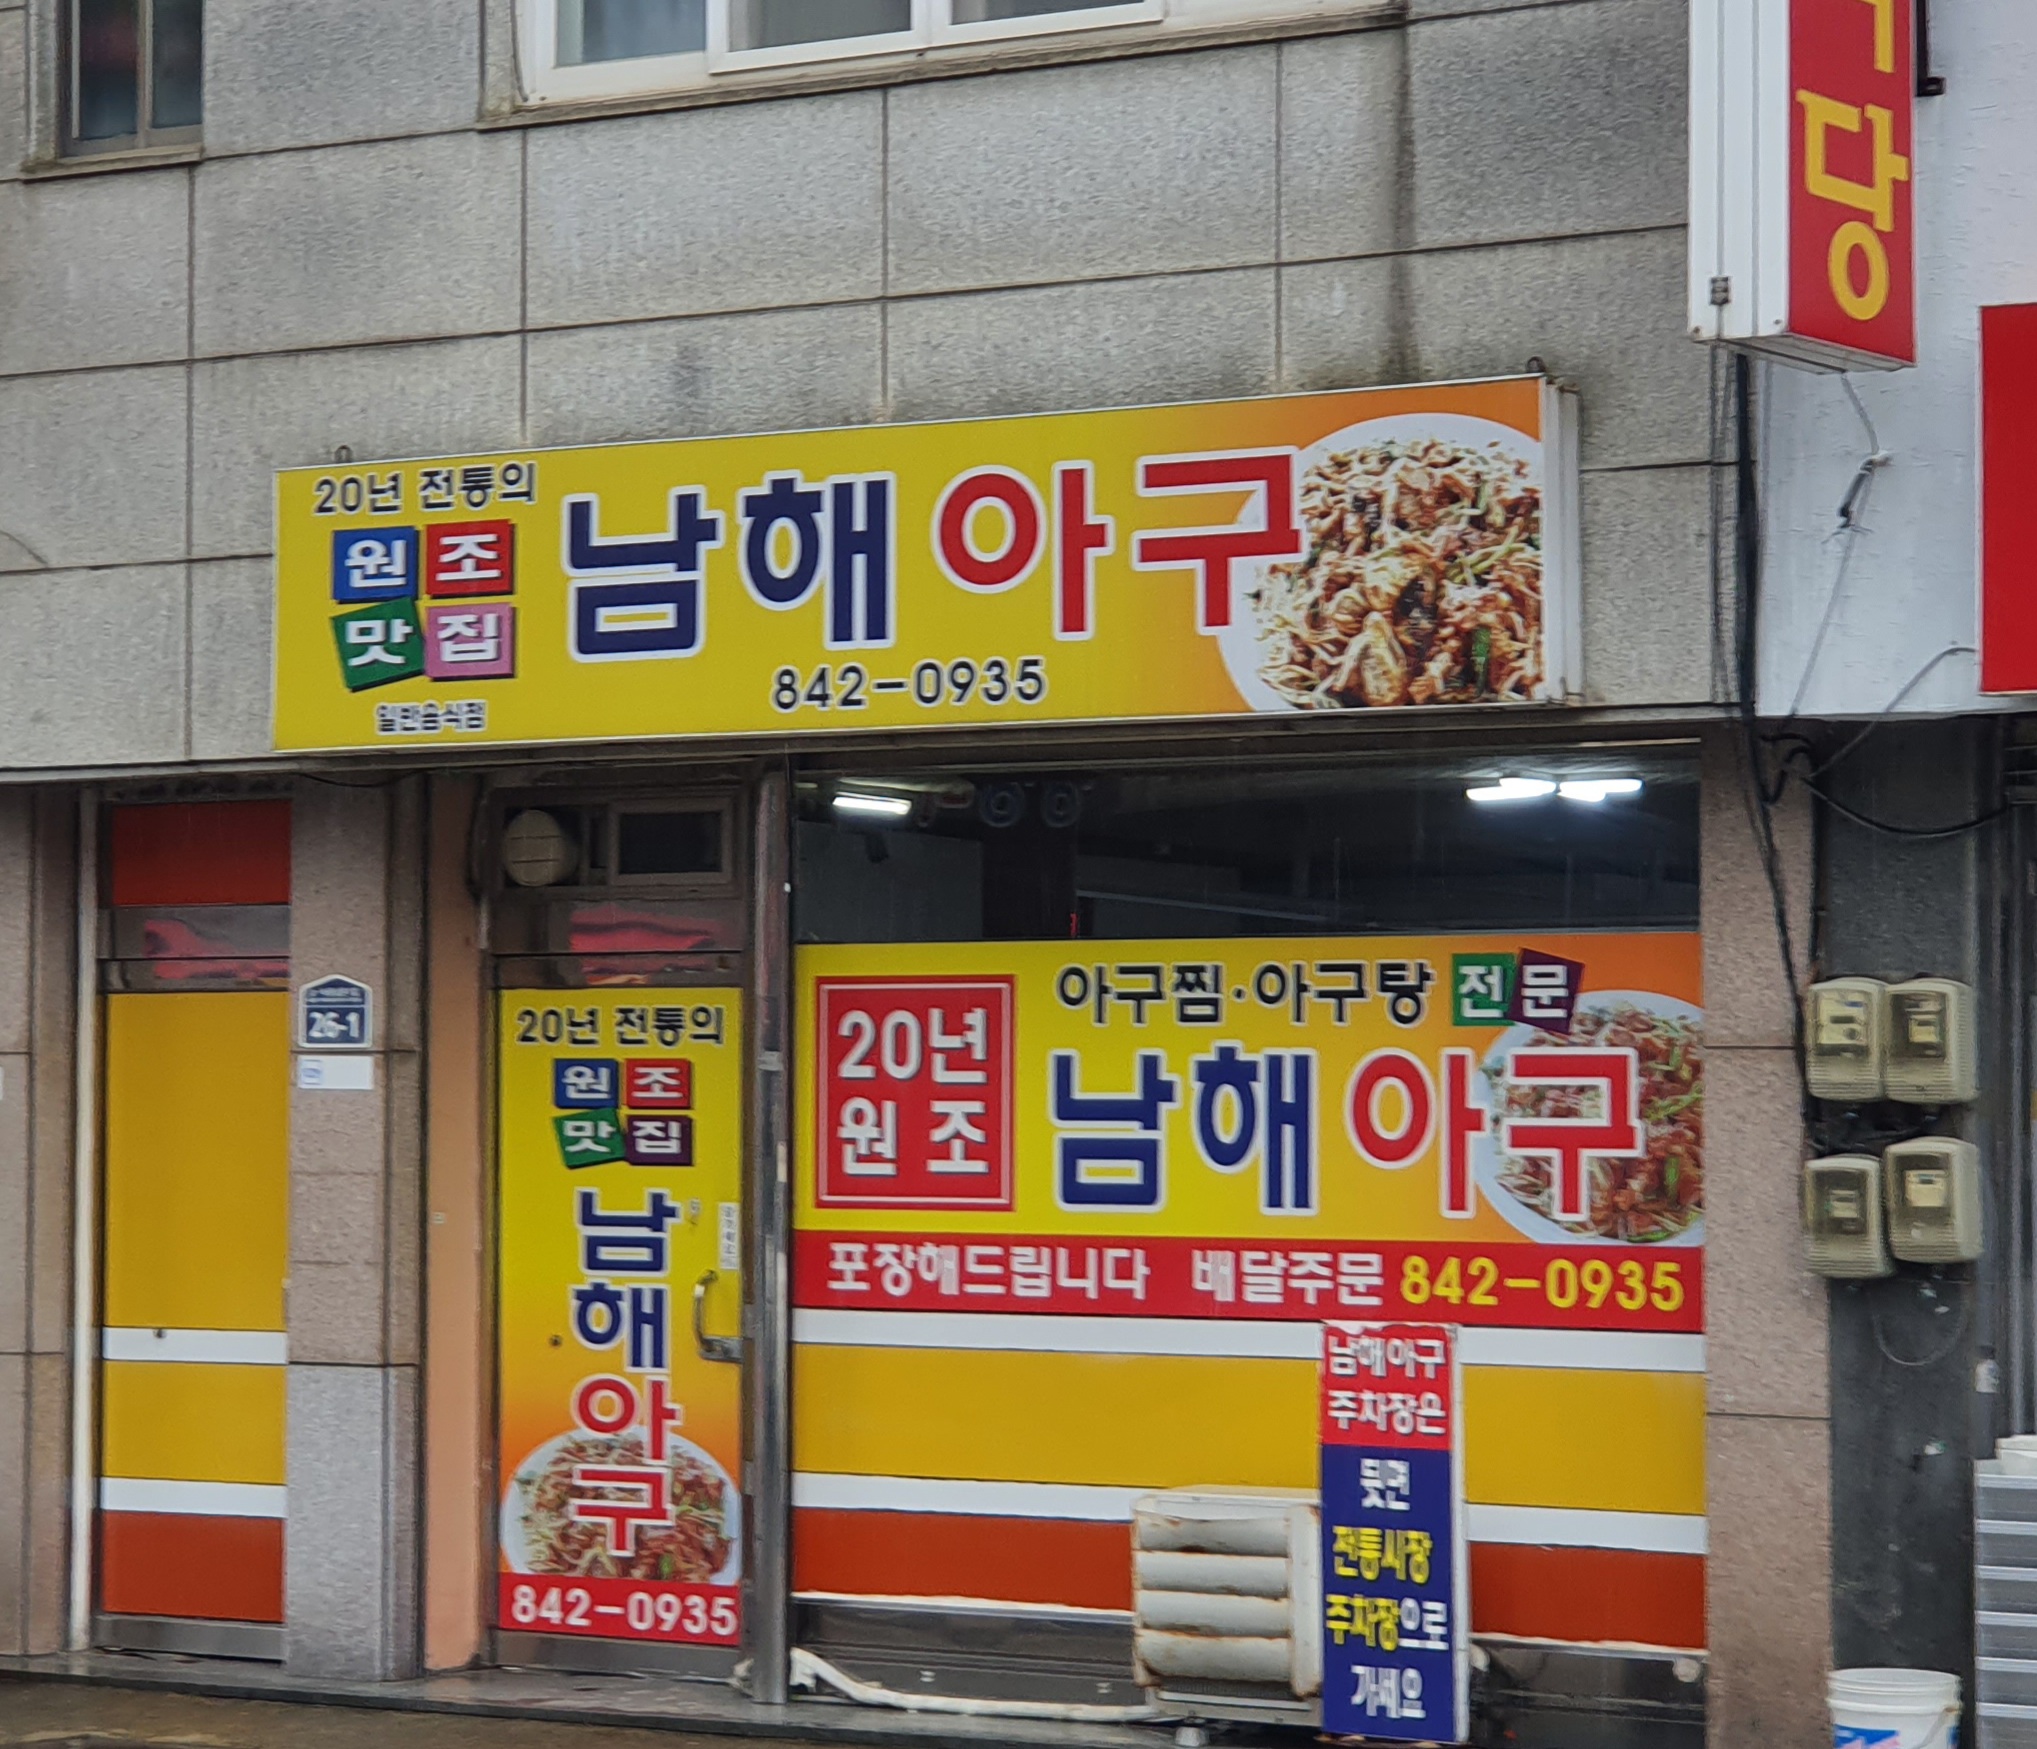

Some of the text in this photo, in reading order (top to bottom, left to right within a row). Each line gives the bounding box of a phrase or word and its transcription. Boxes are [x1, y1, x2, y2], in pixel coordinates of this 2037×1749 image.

[314, 460, 536, 516] 20년 전통의
[771, 656, 1047, 711] 842-0935
[1457, 963, 1570, 1020] 전문
[515, 1005, 725, 1047] 20년 전통의
[836, 1007, 989, 1084] 20년
[827, 1241, 1687, 1312] 포장해드립니다 배달주문 842-0935
[1327, 1332, 1446, 1379] 남해아구
[1327, 1388, 1447, 1436] 주차장은
[511, 1584, 739, 1636] 842-0935
[1325, 1593, 1450, 1652] 주차장으로
[1350, 1664, 1427, 1720] 가세요
